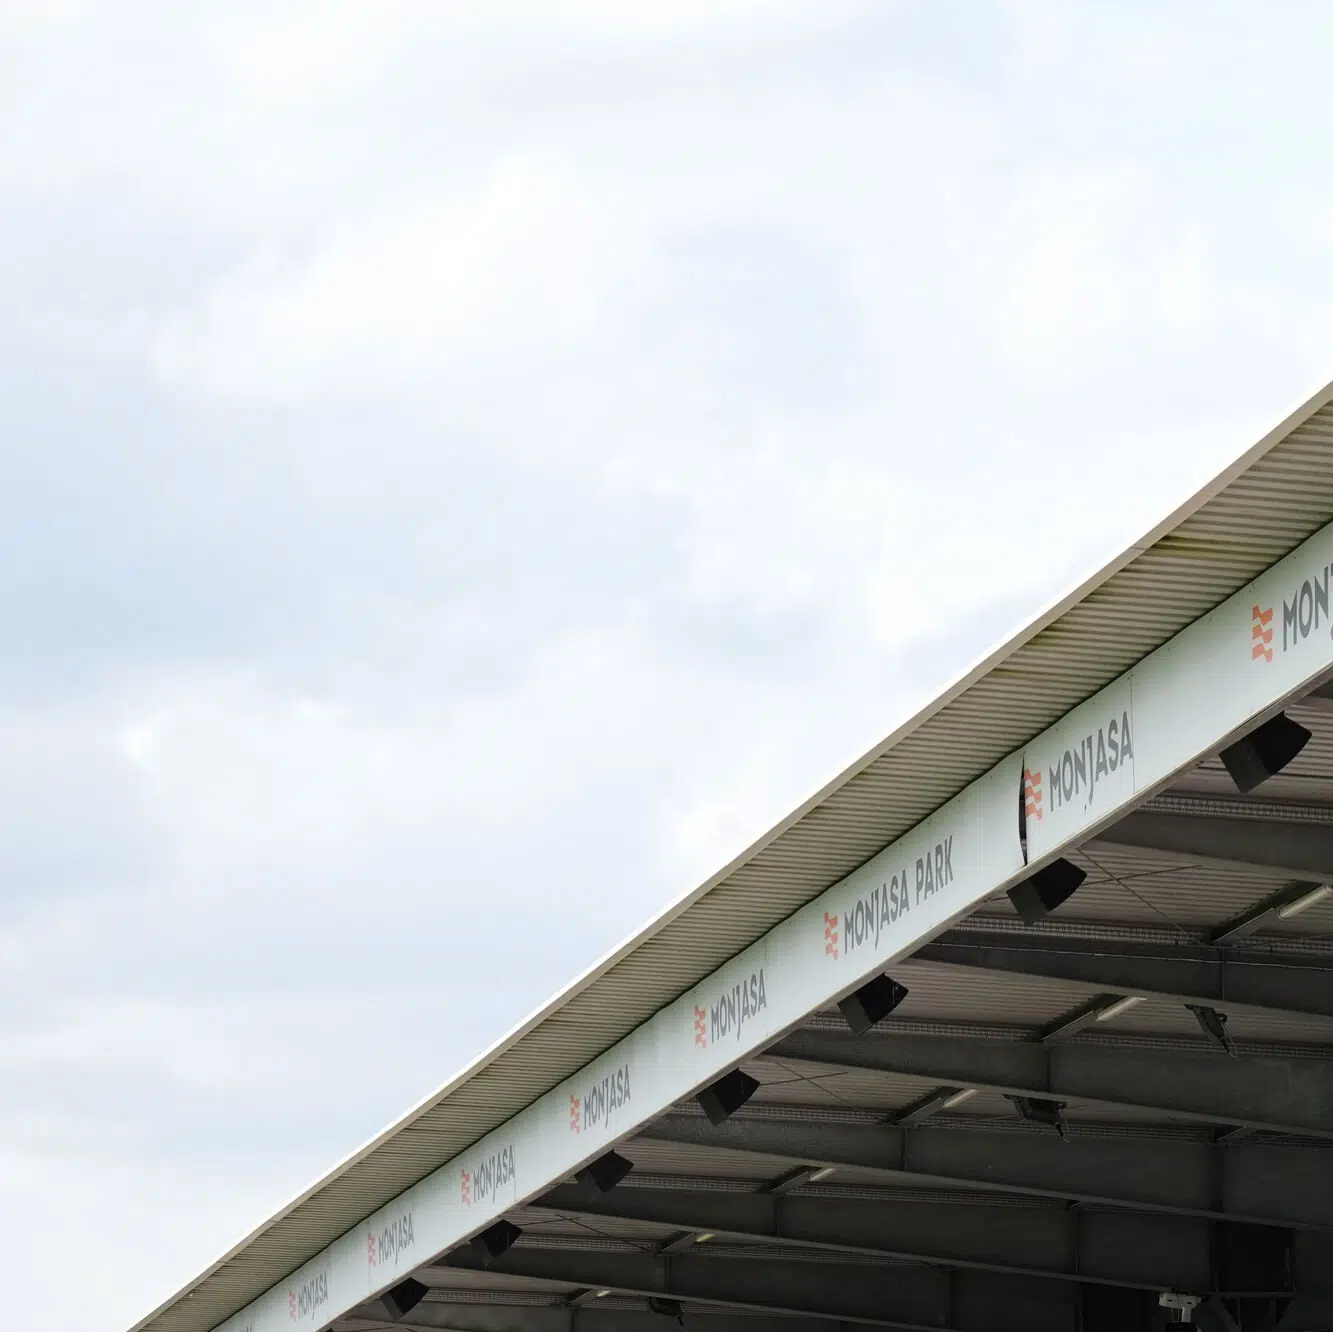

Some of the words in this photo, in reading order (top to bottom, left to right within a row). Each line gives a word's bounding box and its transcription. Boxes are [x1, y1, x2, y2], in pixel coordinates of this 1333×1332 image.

[1048, 711, 1133, 812] MONJASA
[843, 869, 910, 954] MONJASA
[915, 835, 954, 906] PARK
[711, 968, 767, 1044] MONJASA
[583, 1064, 631, 1131] MONJASA
[473, 1145, 516, 1205] MONJASA
[378, 1212, 415, 1265] MONJASA
[298, 1271, 328, 1321] MONJASA
